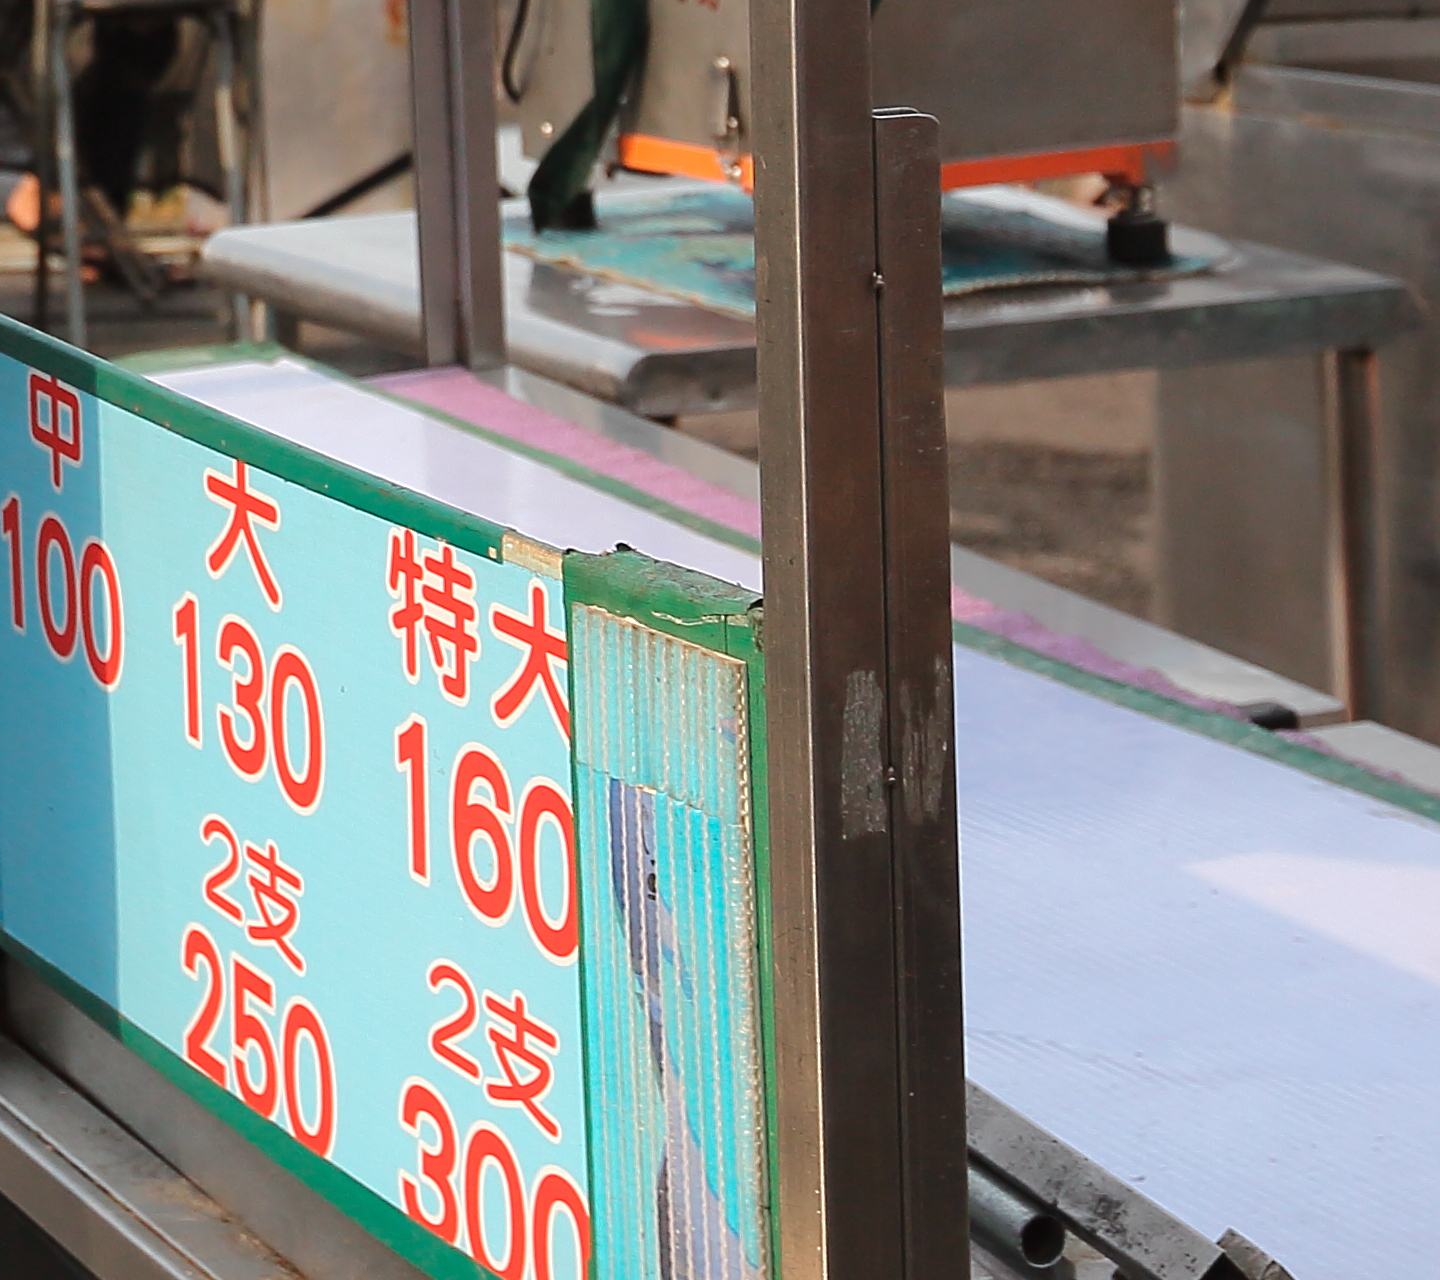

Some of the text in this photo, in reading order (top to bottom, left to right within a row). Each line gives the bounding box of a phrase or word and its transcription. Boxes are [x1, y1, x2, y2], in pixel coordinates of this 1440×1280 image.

[29, 372, 82, 490] 中
[1, 496, 124, 692] 100
[205, 460, 280, 610] 大
[174, 593, 325, 813] 130
[386, 528, 571, 745] 特大
[200, 817, 305, 974] 2支
[396, 715, 579, 966] 160
[181, 924, 336, 1158] 250
[428, 960, 560, 1141] 2支
[399, 1080, 592, 1280] 300
